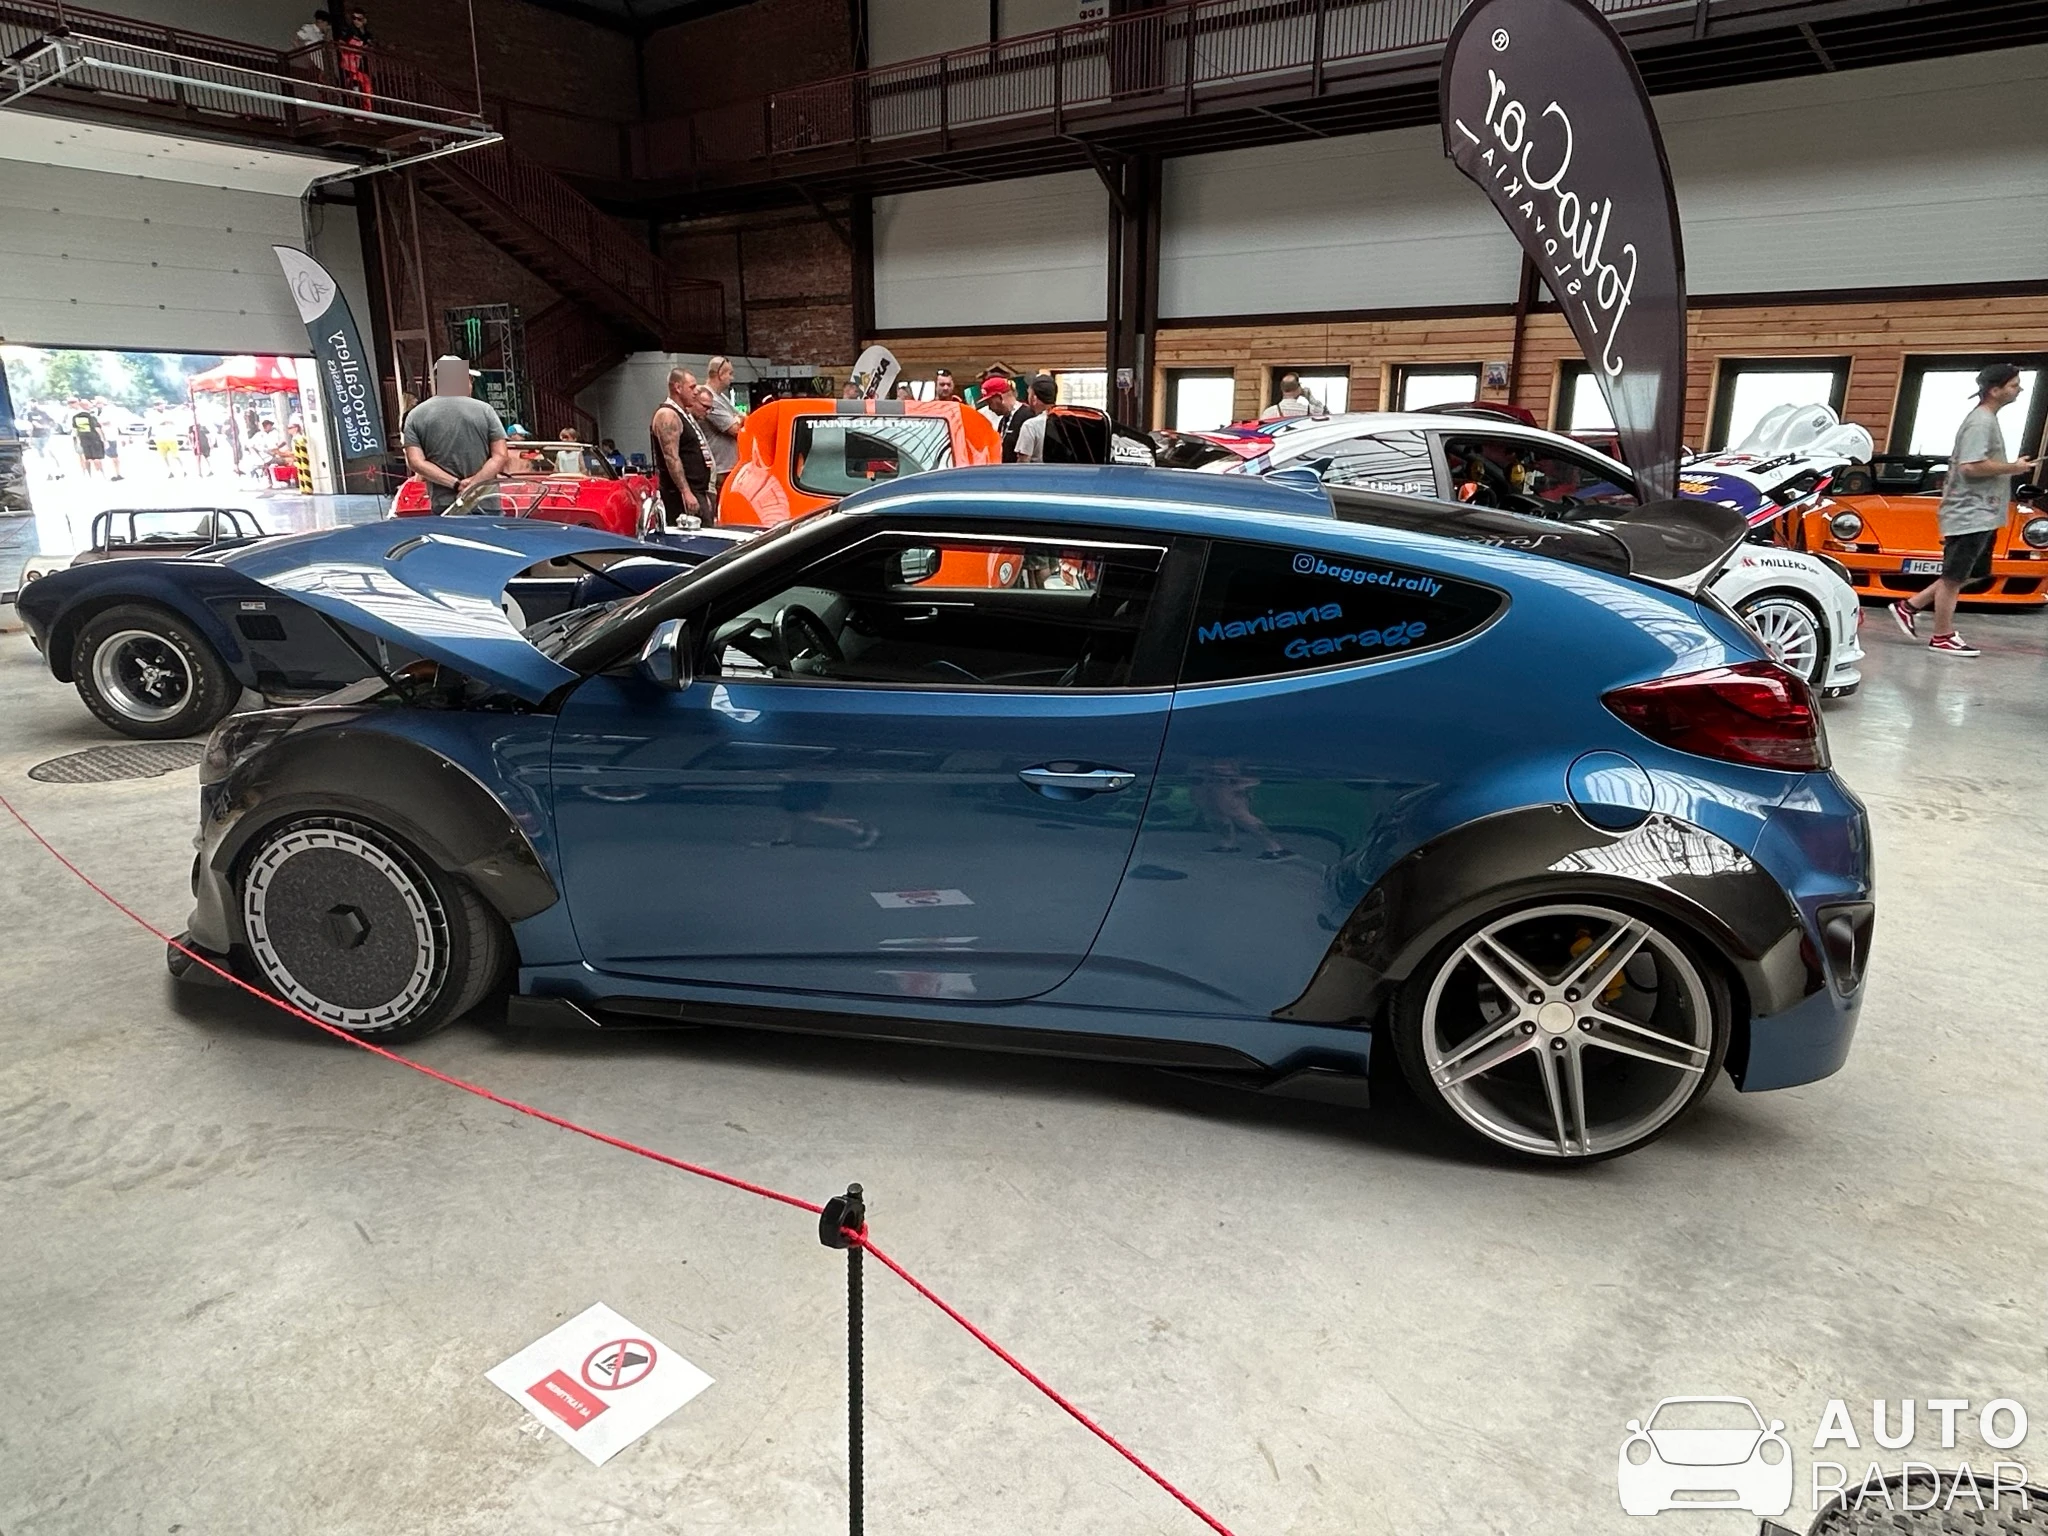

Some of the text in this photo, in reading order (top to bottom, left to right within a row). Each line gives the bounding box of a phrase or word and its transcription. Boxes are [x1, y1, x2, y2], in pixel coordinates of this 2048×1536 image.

[806, 420, 850, 429] TUNING
[1315, 559, 1442, 597] bagged.rally
[1198, 602, 1343, 643] Maniana
[1284, 621, 1427, 658] Garage
